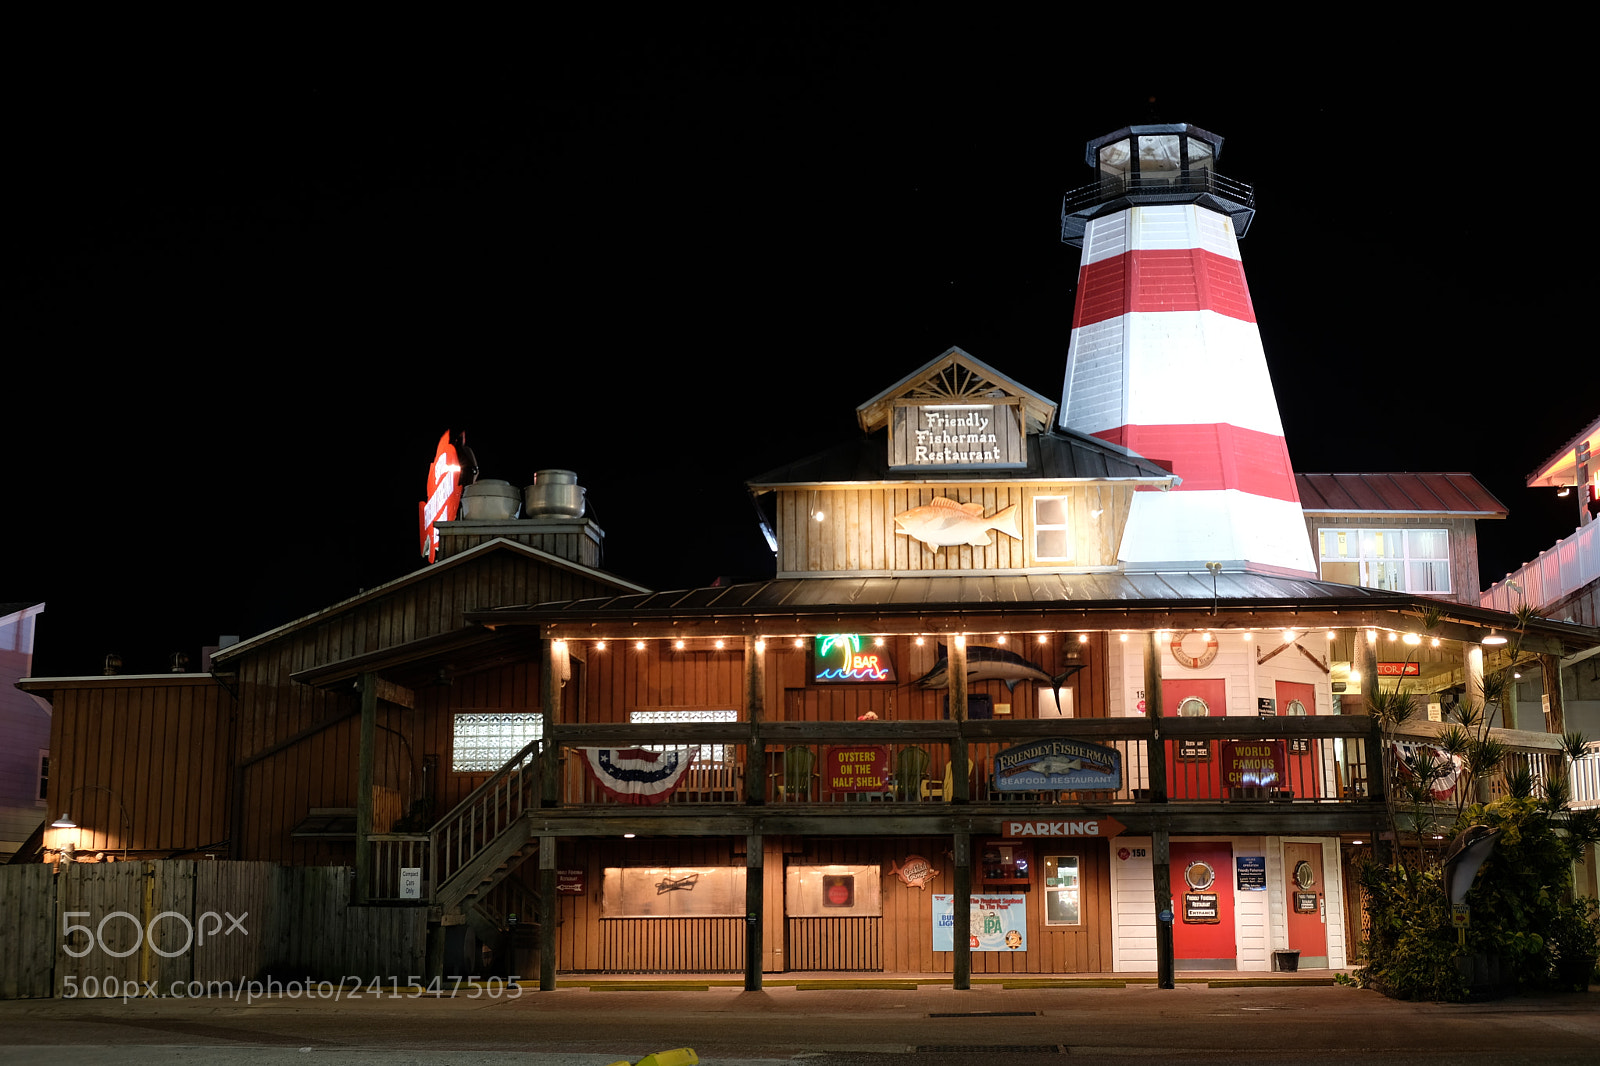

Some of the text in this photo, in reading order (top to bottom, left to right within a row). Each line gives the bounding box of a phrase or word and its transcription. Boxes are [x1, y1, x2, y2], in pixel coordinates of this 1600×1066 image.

[925, 412, 989, 431] Friendly
[915, 430, 997, 445] Fisherman
[915, 446, 1001, 462] Restaurant
[853, 655, 880, 671] BAR
[838, 752, 876, 762] OYSTERS
[1000, 745, 1052, 770] FRIENDLY
[1052, 742, 1115, 767] FISHERMAN
[1235, 746, 1271, 757] WORLD
[841, 764, 871, 775] ON THE
[1232, 759, 1275, 770] FAMOUS
[832, 776, 882, 788] HALF SHELL
[1001, 776, 1112, 786] SEAFOOD RESTAURANT
[1010, 821, 1099, 836] PARKING
[1132, 849, 1146, 857] 150
[984, 918, 1003, 934] IPA
